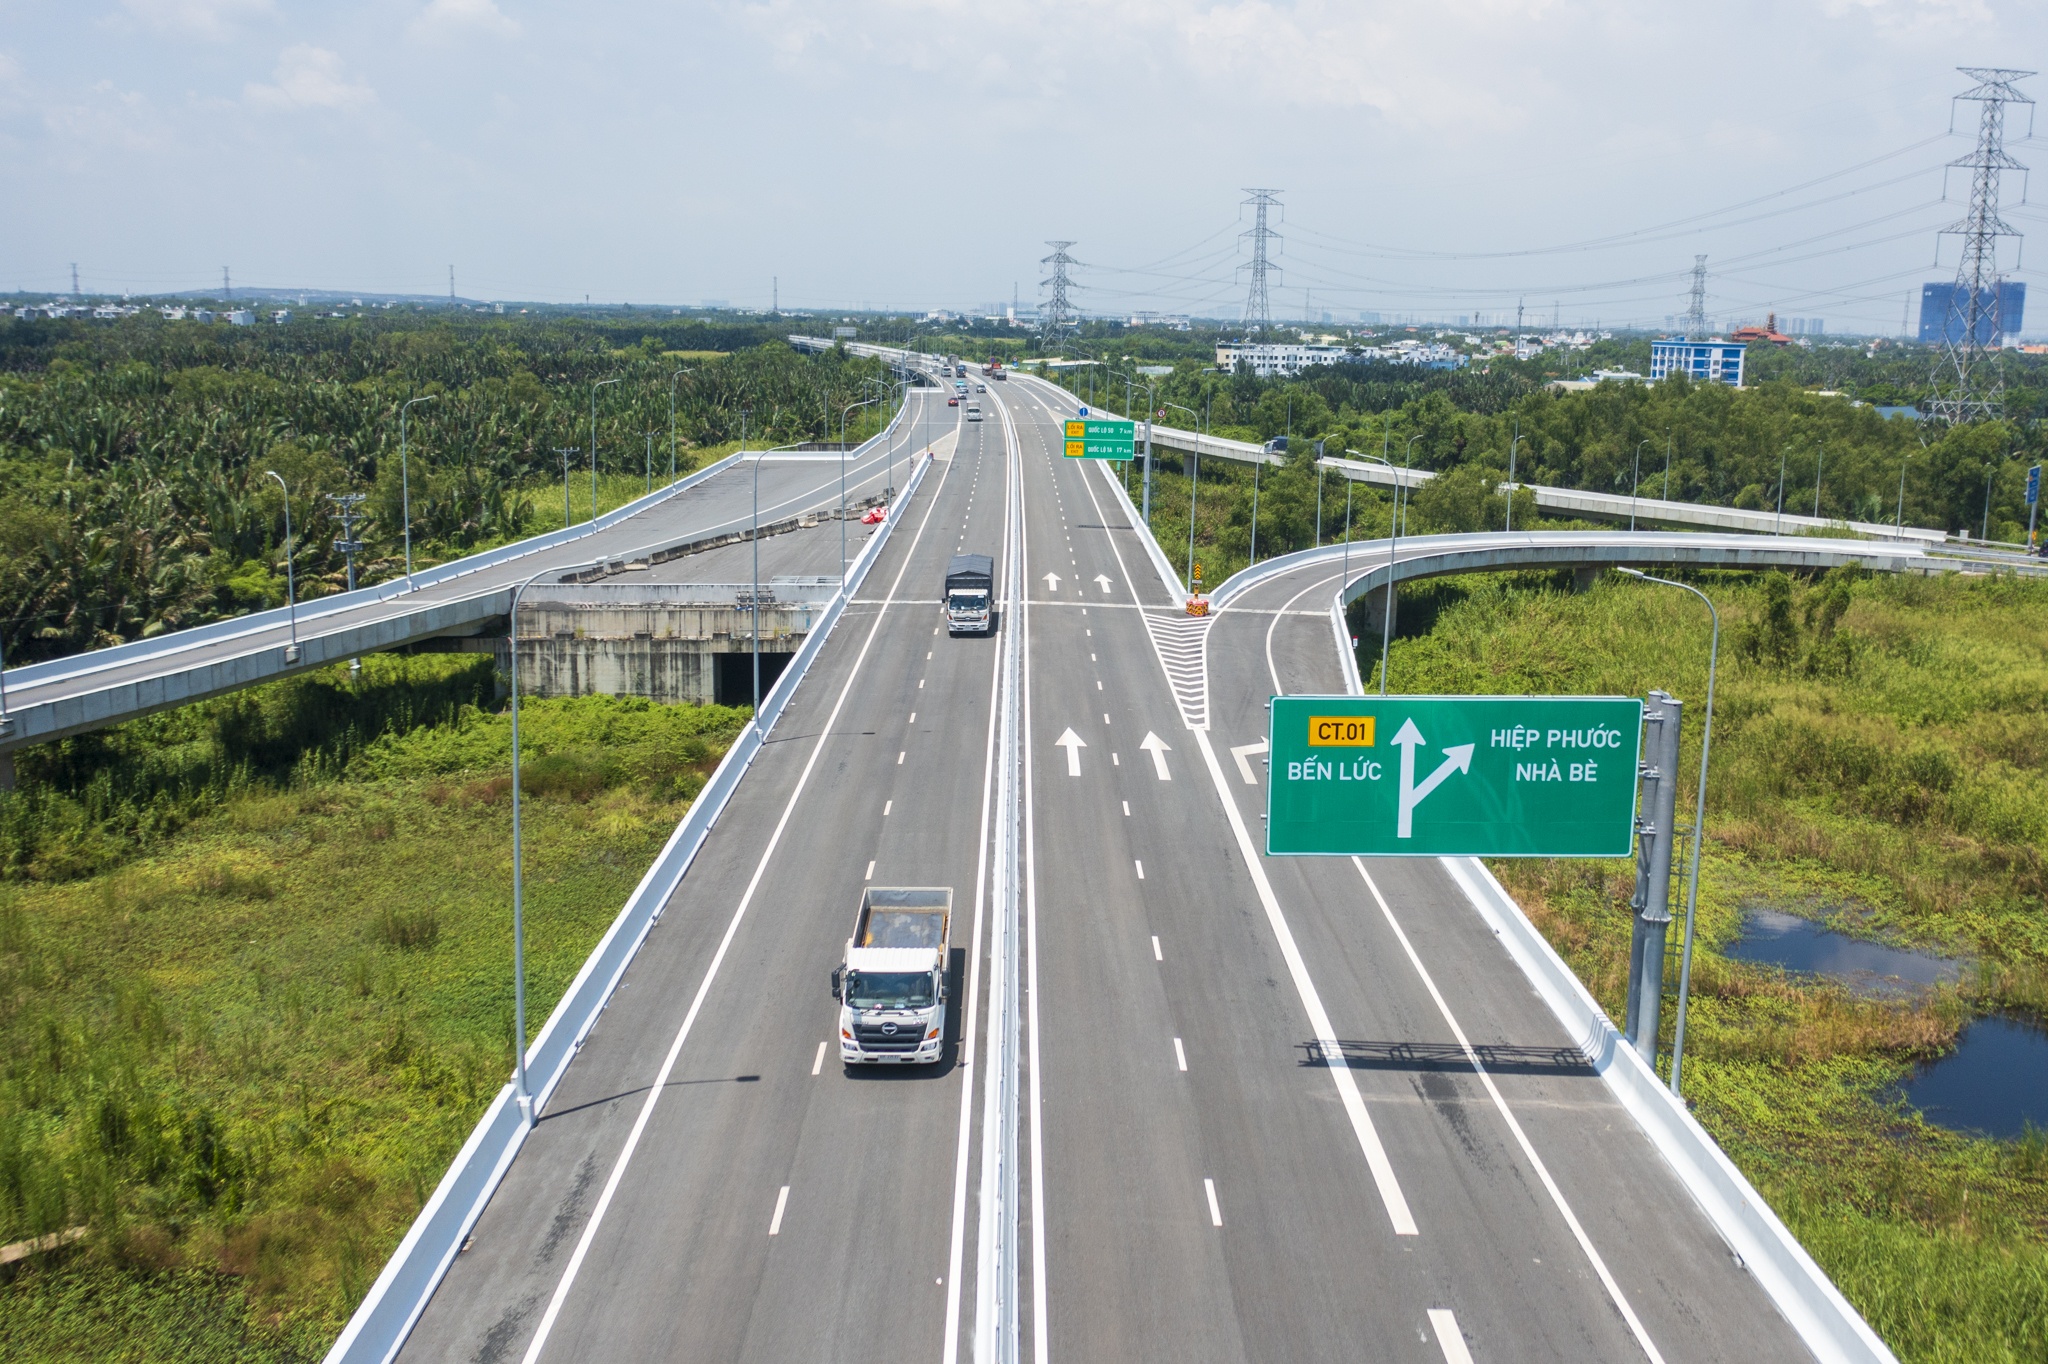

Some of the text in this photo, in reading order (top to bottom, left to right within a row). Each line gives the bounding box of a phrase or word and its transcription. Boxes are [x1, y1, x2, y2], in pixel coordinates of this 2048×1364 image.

[1100, 445, 1106, 453] LỘ
[1318, 723, 1365, 740] CT.01
[1490, 723, 1621, 751] HIỆP PHƯỚC
[1288, 755, 1382, 780] BẾN LỨC
[1515, 758, 1598, 782] NHÀ BÈ
